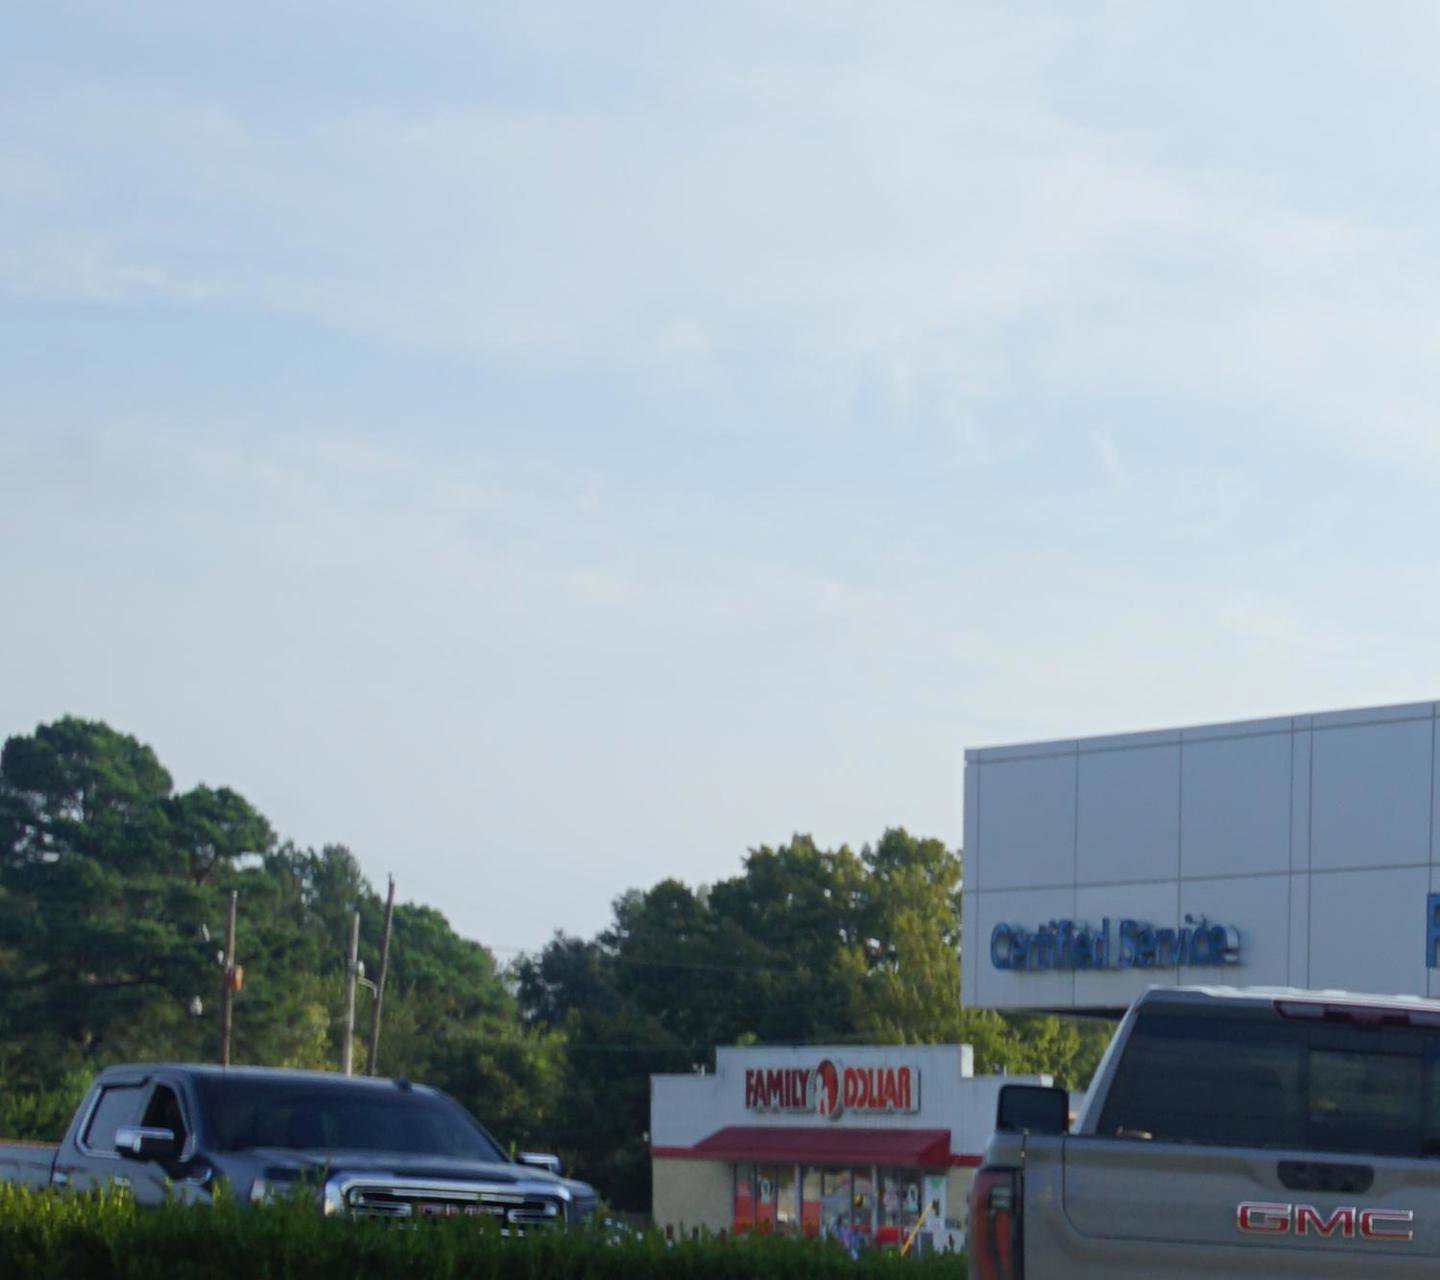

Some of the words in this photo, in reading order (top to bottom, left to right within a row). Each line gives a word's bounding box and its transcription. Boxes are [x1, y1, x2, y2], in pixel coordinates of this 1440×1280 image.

[990, 917, 1110, 971] Certified
[1119, 914, 1241, 968] Service
[745, 1067, 811, 1110] FAMILY
[843, 1066, 912, 1109] DOLLAR
[1237, 1201, 1414, 1241] GMC
